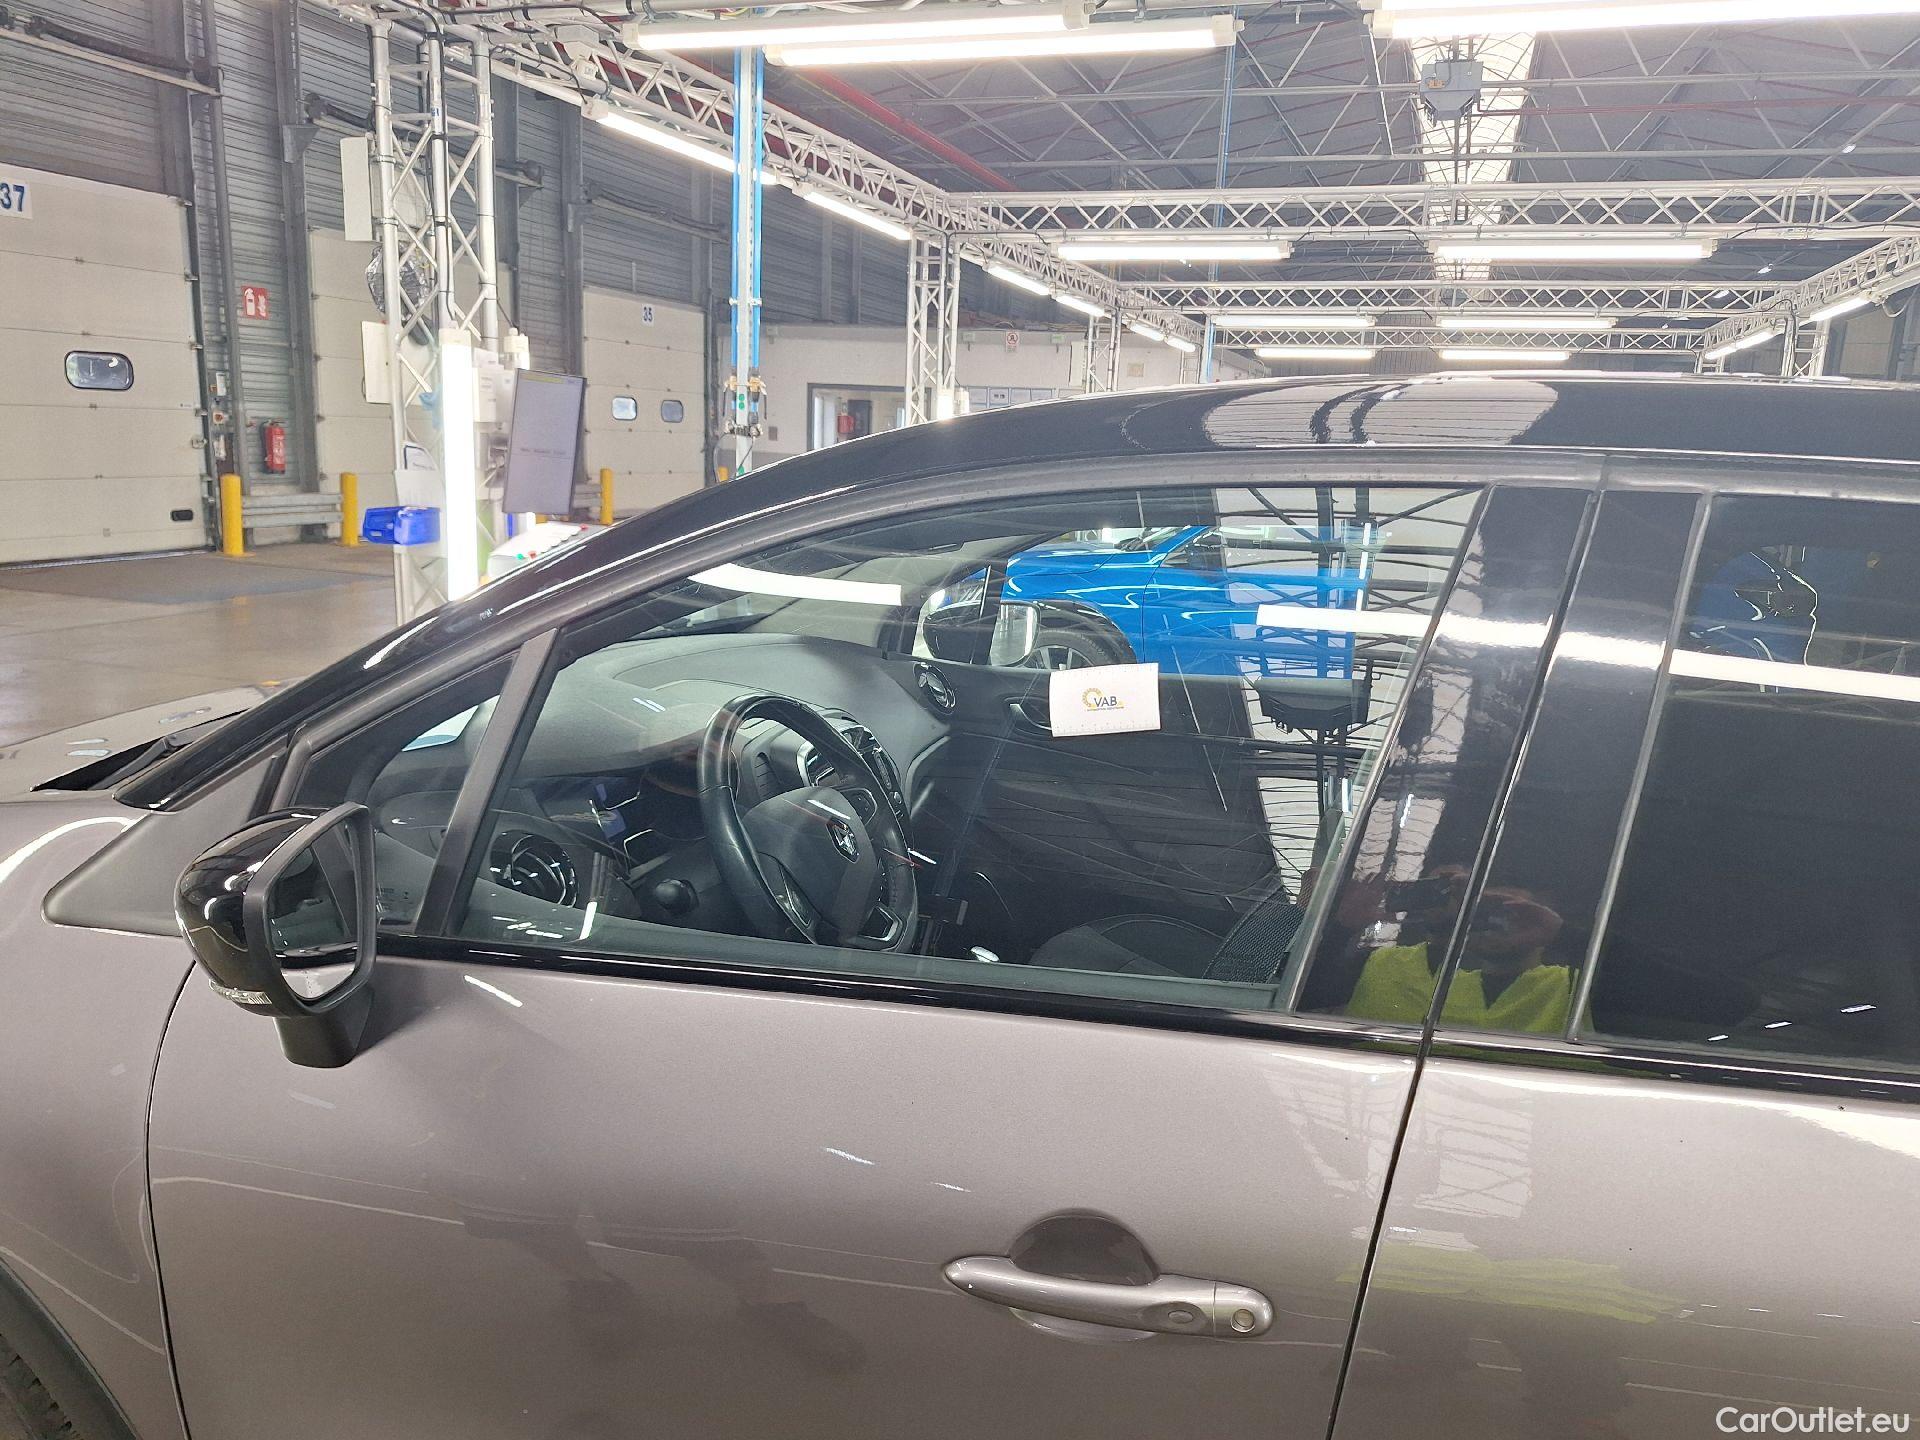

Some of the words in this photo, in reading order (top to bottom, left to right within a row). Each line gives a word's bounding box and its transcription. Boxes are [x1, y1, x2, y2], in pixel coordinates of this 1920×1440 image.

[0, 182, 25, 212] 37
[643, 306, 653, 322] 35
[1093, 695, 1118, 708] VAB
